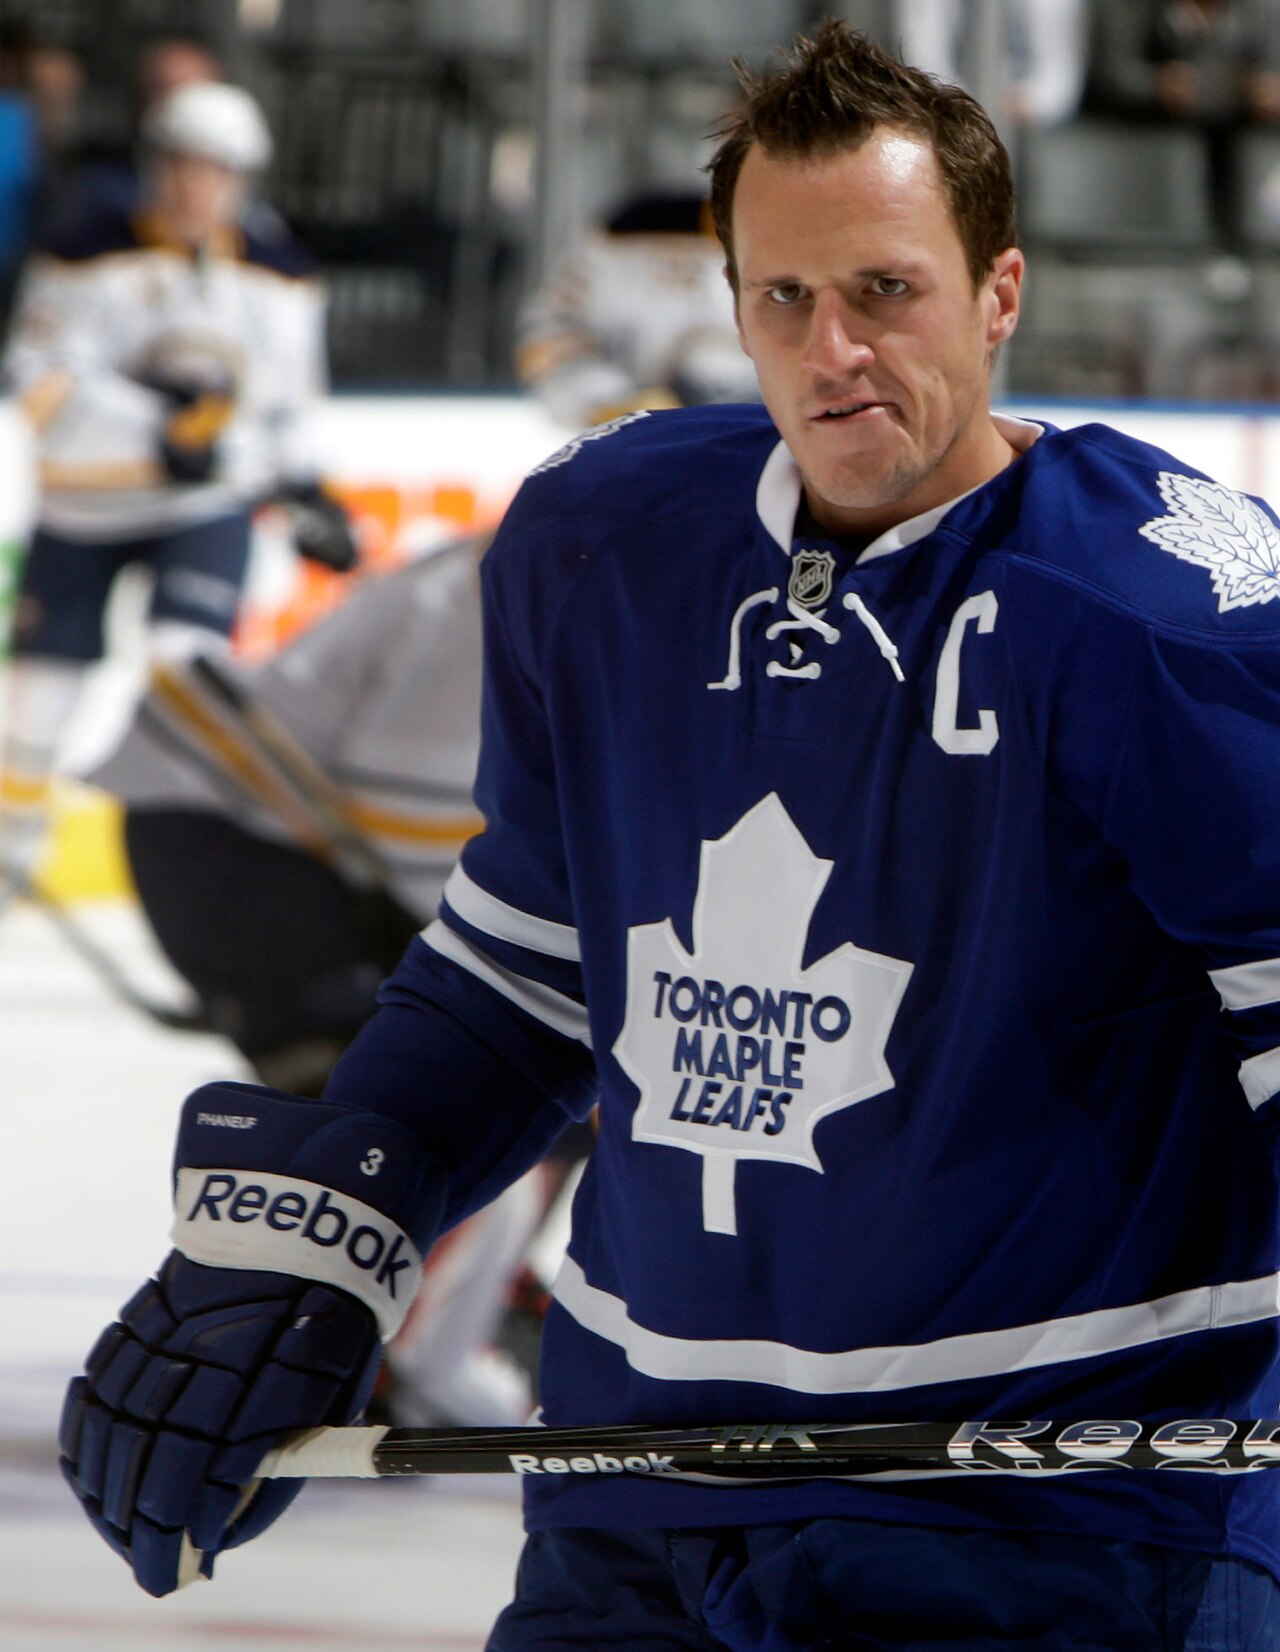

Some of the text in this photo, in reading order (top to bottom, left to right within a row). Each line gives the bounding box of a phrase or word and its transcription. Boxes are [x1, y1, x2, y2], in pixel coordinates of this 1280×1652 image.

[931, 590, 1000, 756] C
[653, 970, 851, 1043] TORONTO
[672, 1026, 806, 1090] MAPLE
[196, 1111, 259, 1130] PHANEUF
[669, 1077, 794, 1136] LEAFS
[359, 1147, 386, 1177] 3
[186, 1173, 411, 1300] Reebok
[507, 1452, 681, 1475] Reebok
